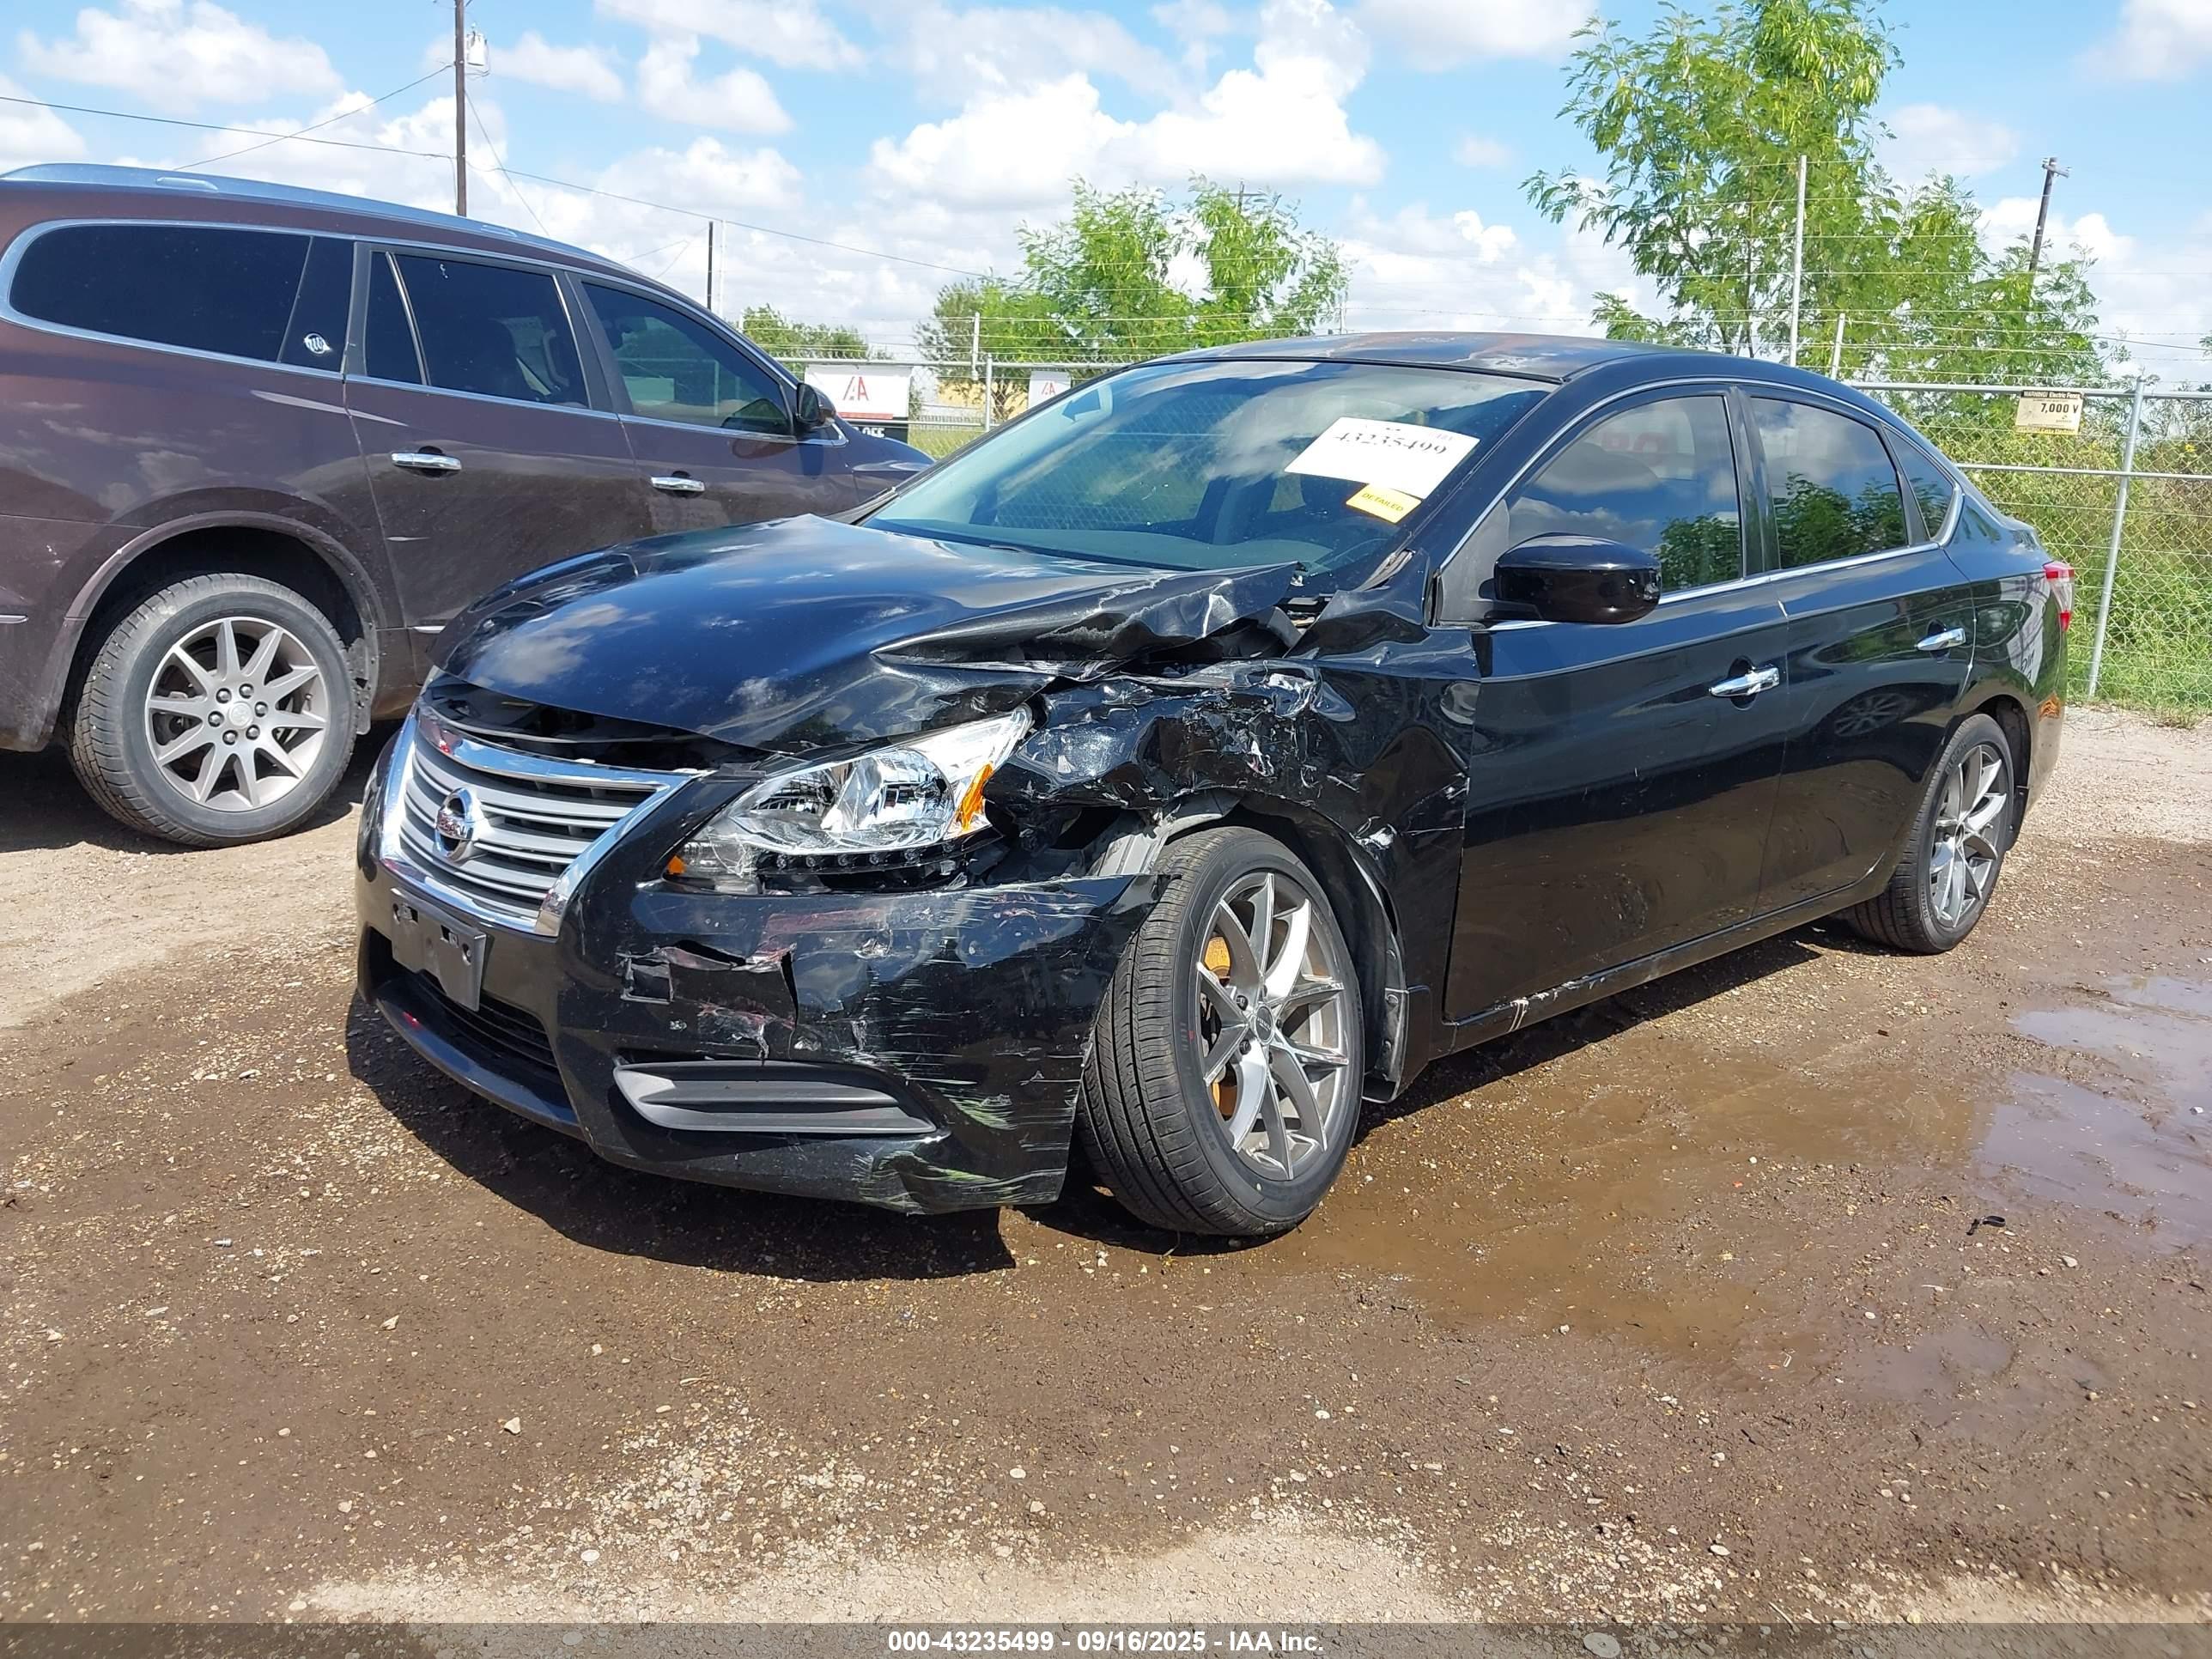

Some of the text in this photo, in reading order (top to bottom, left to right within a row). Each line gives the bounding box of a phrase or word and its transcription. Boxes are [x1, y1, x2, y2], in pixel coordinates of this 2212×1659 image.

[2040, 403, 2079, 414] 7,000 V
[1333, 431, 1447, 454] 43235499
[1361, 492, 1404, 512] DETAILED
